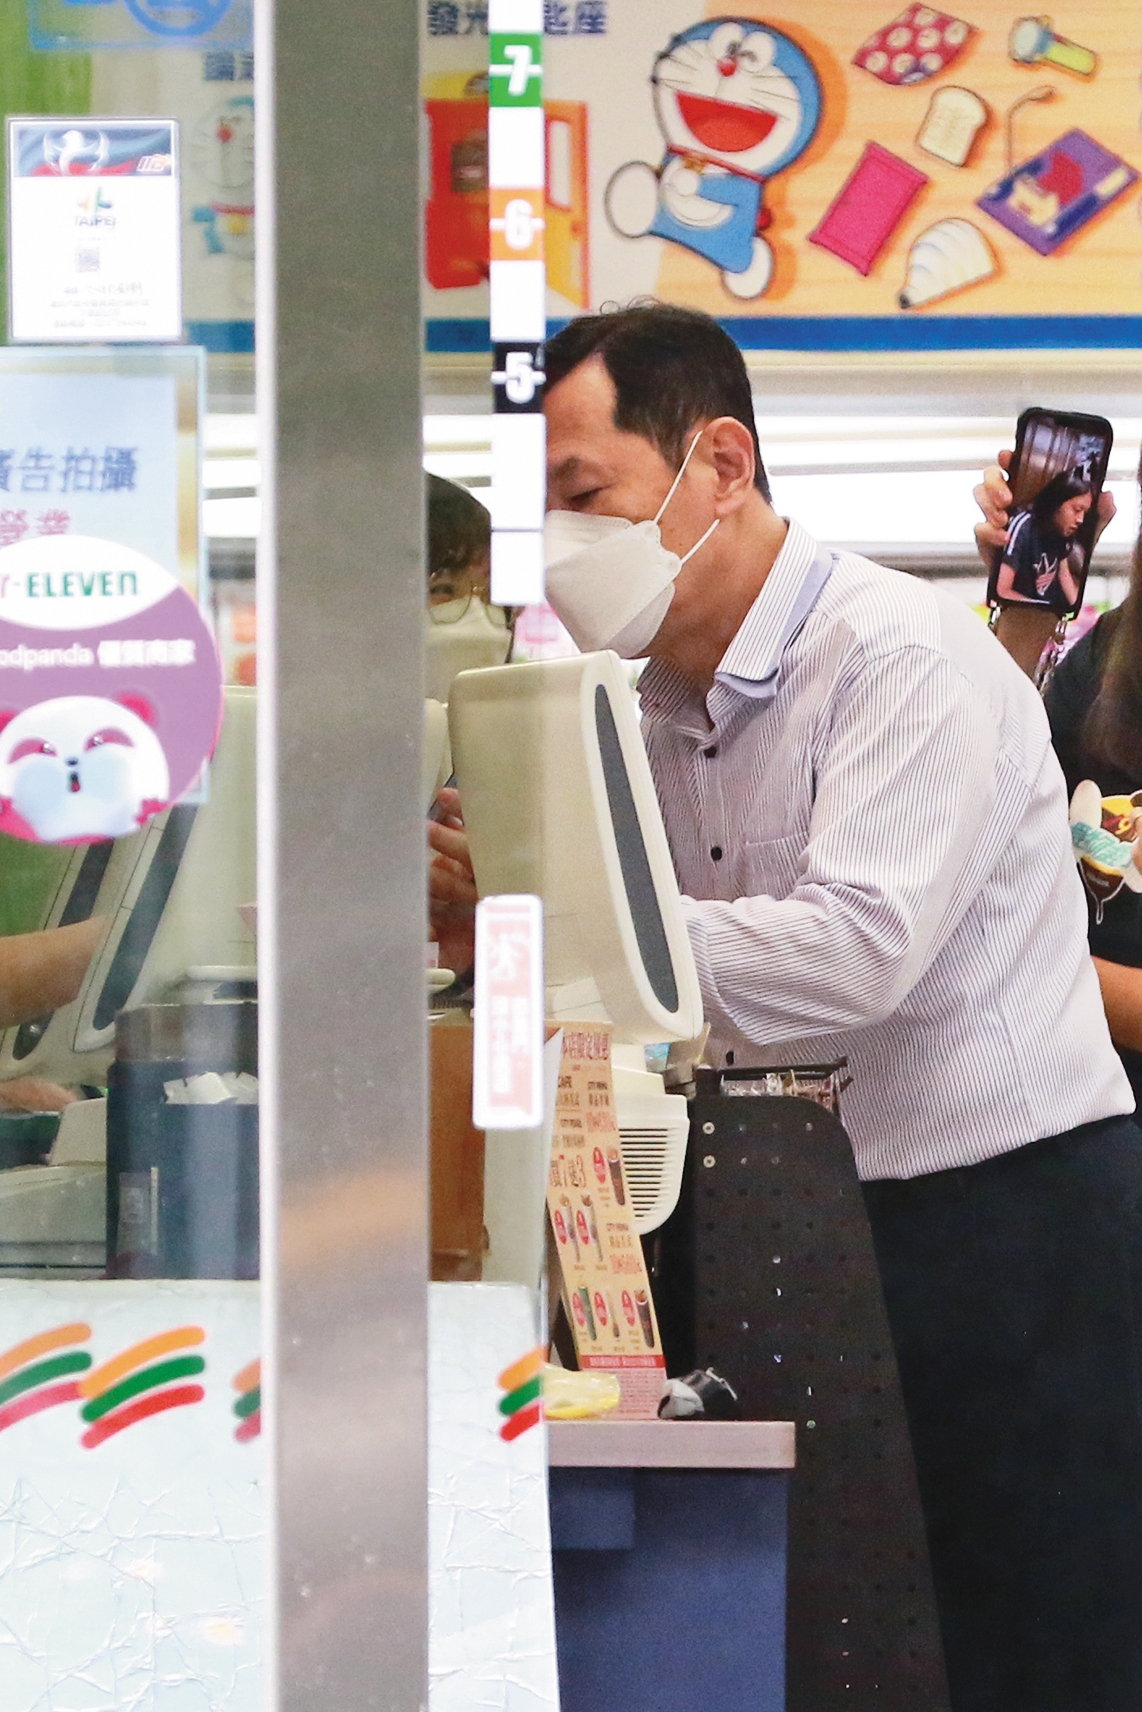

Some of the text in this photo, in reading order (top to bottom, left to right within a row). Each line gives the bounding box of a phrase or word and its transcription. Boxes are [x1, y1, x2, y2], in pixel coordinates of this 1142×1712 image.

[503, 44, 533, 96] 7
[505, 198, 534, 250] 6
[504, 352, 536, 403] 5
